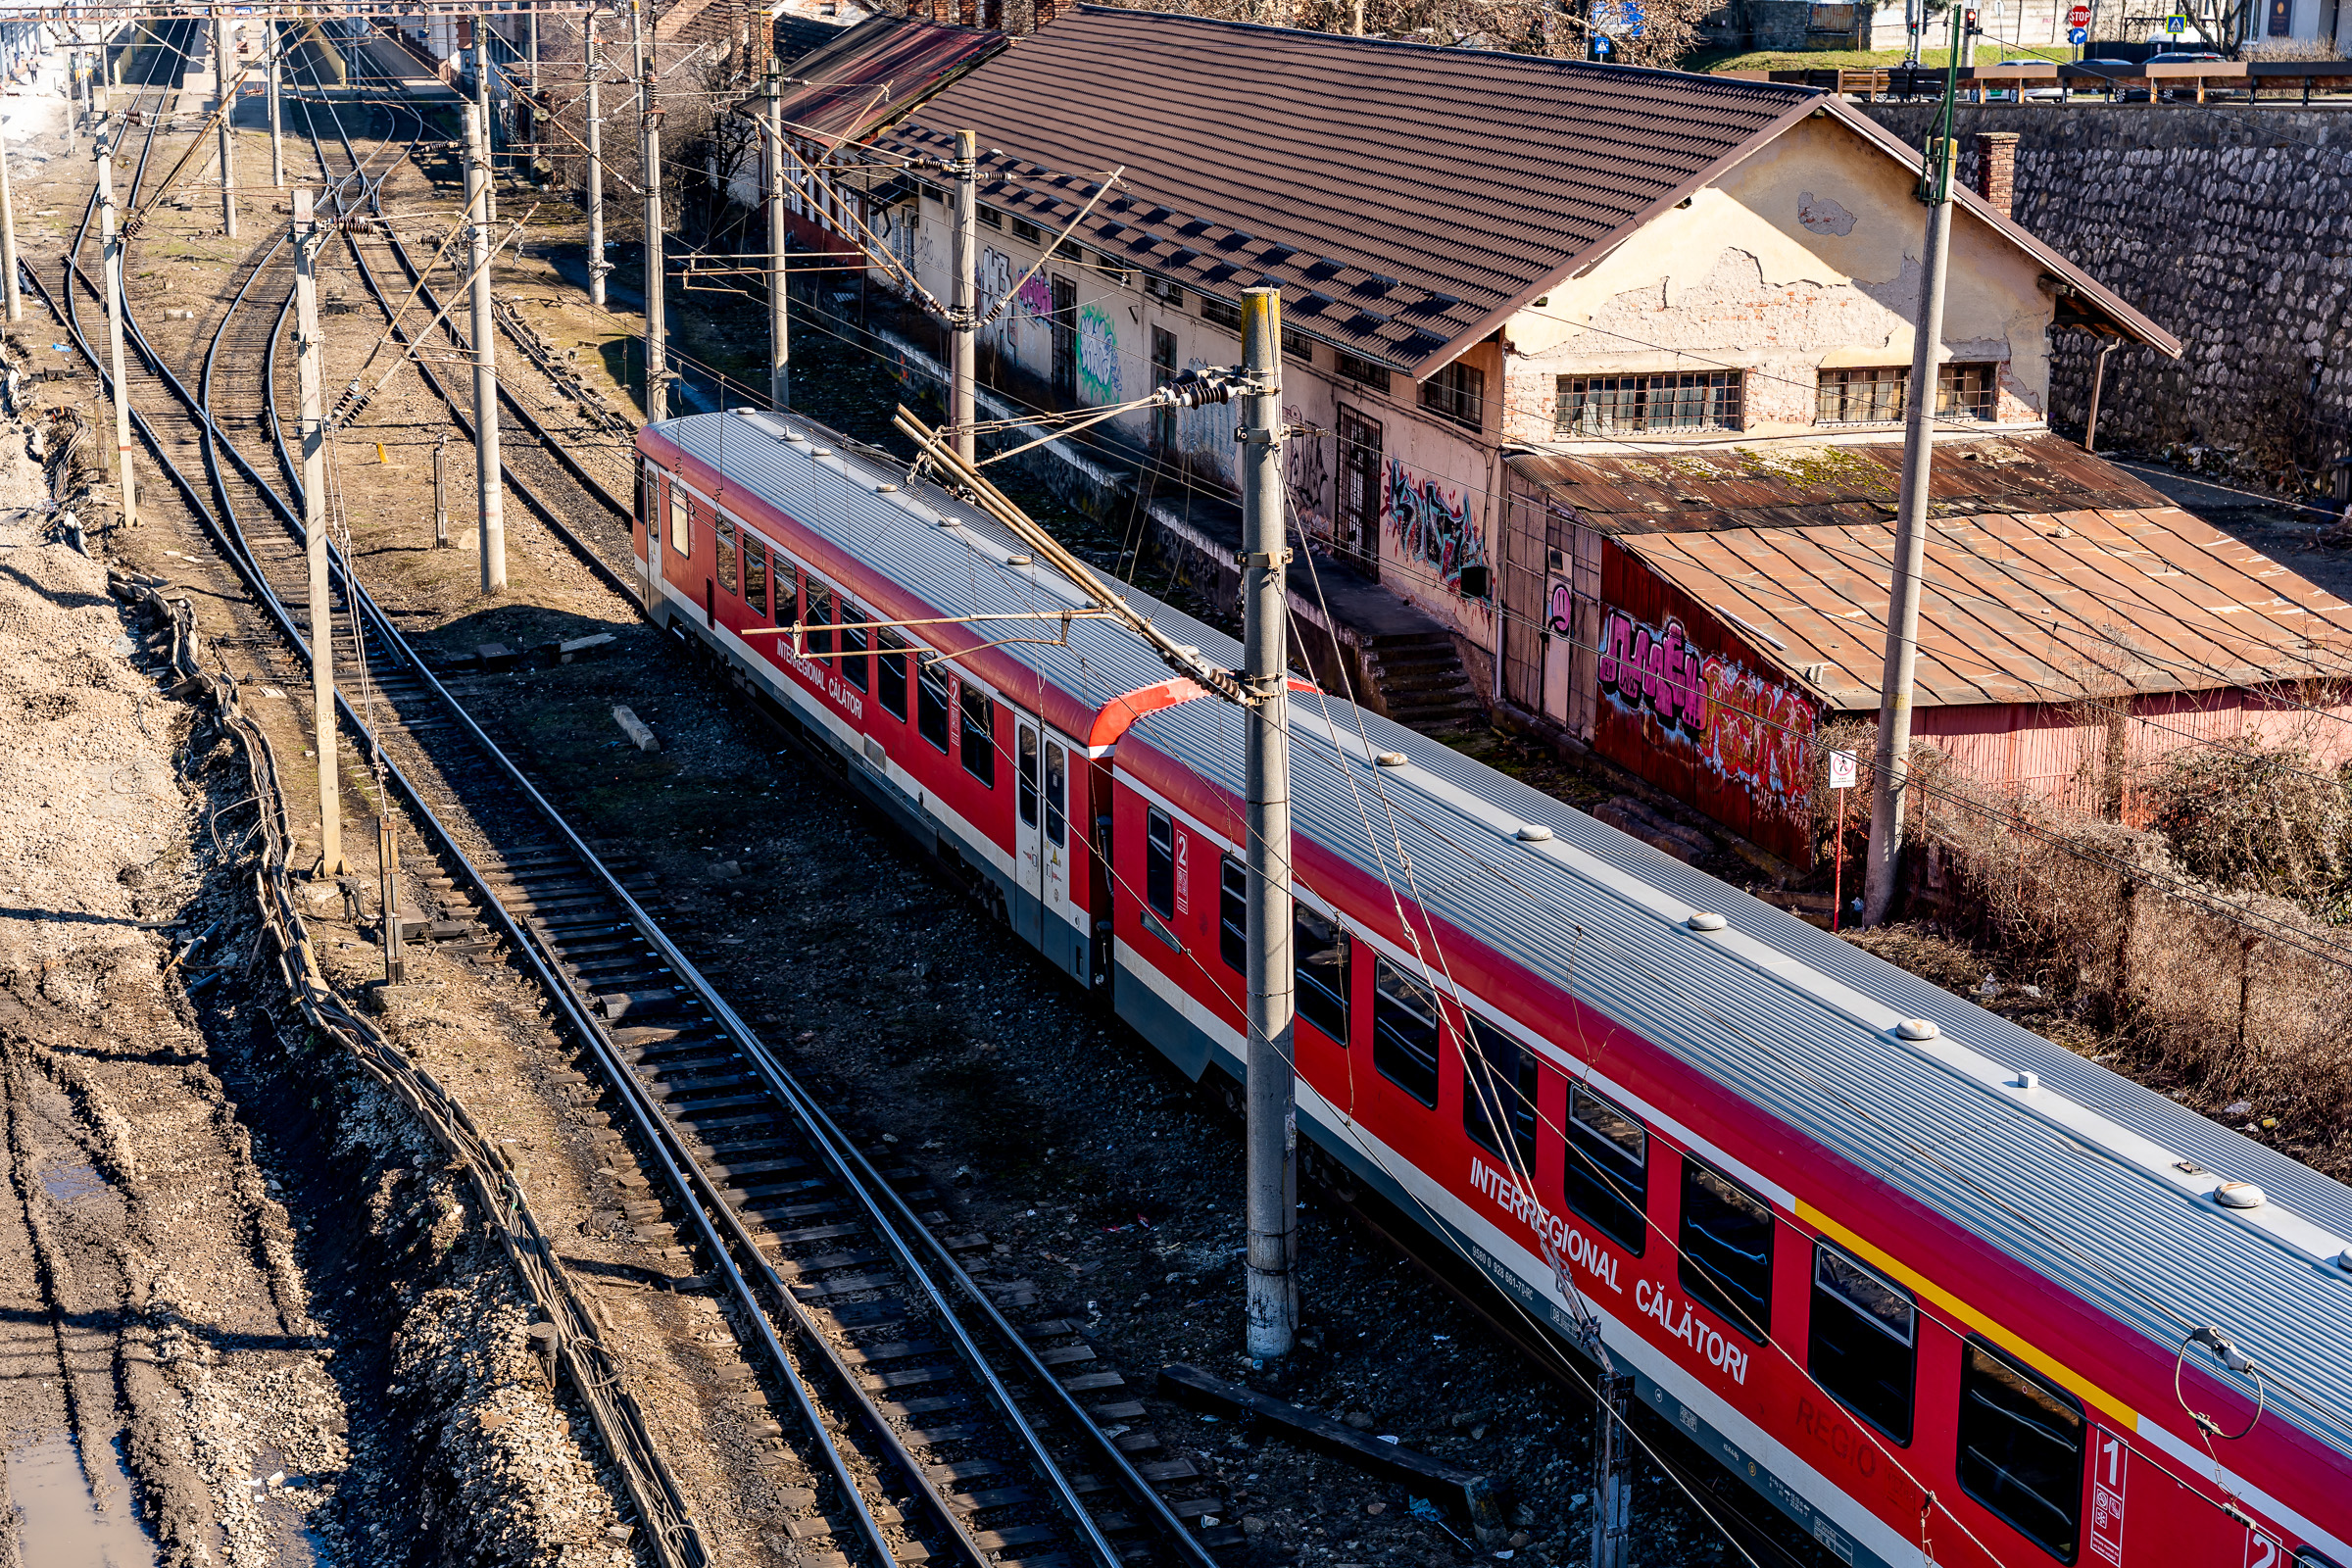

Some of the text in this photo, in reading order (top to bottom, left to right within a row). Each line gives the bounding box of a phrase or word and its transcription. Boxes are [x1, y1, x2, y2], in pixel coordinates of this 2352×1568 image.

[2069, 11, 2090, 23] STOP
[828, 676, 862, 720] CĂLĂTORI
[951, 679, 958, 707] 2
[1178, 835, 1187, 866] 2
[1471, 1156, 1748, 1386] INTERREGIONAL CĂLĂTORI
[1472, 1246, 1487, 1264] 9580
[1795, 1396, 1876, 1478] REGIO
[2103, 1439, 2119, 1487] 1
